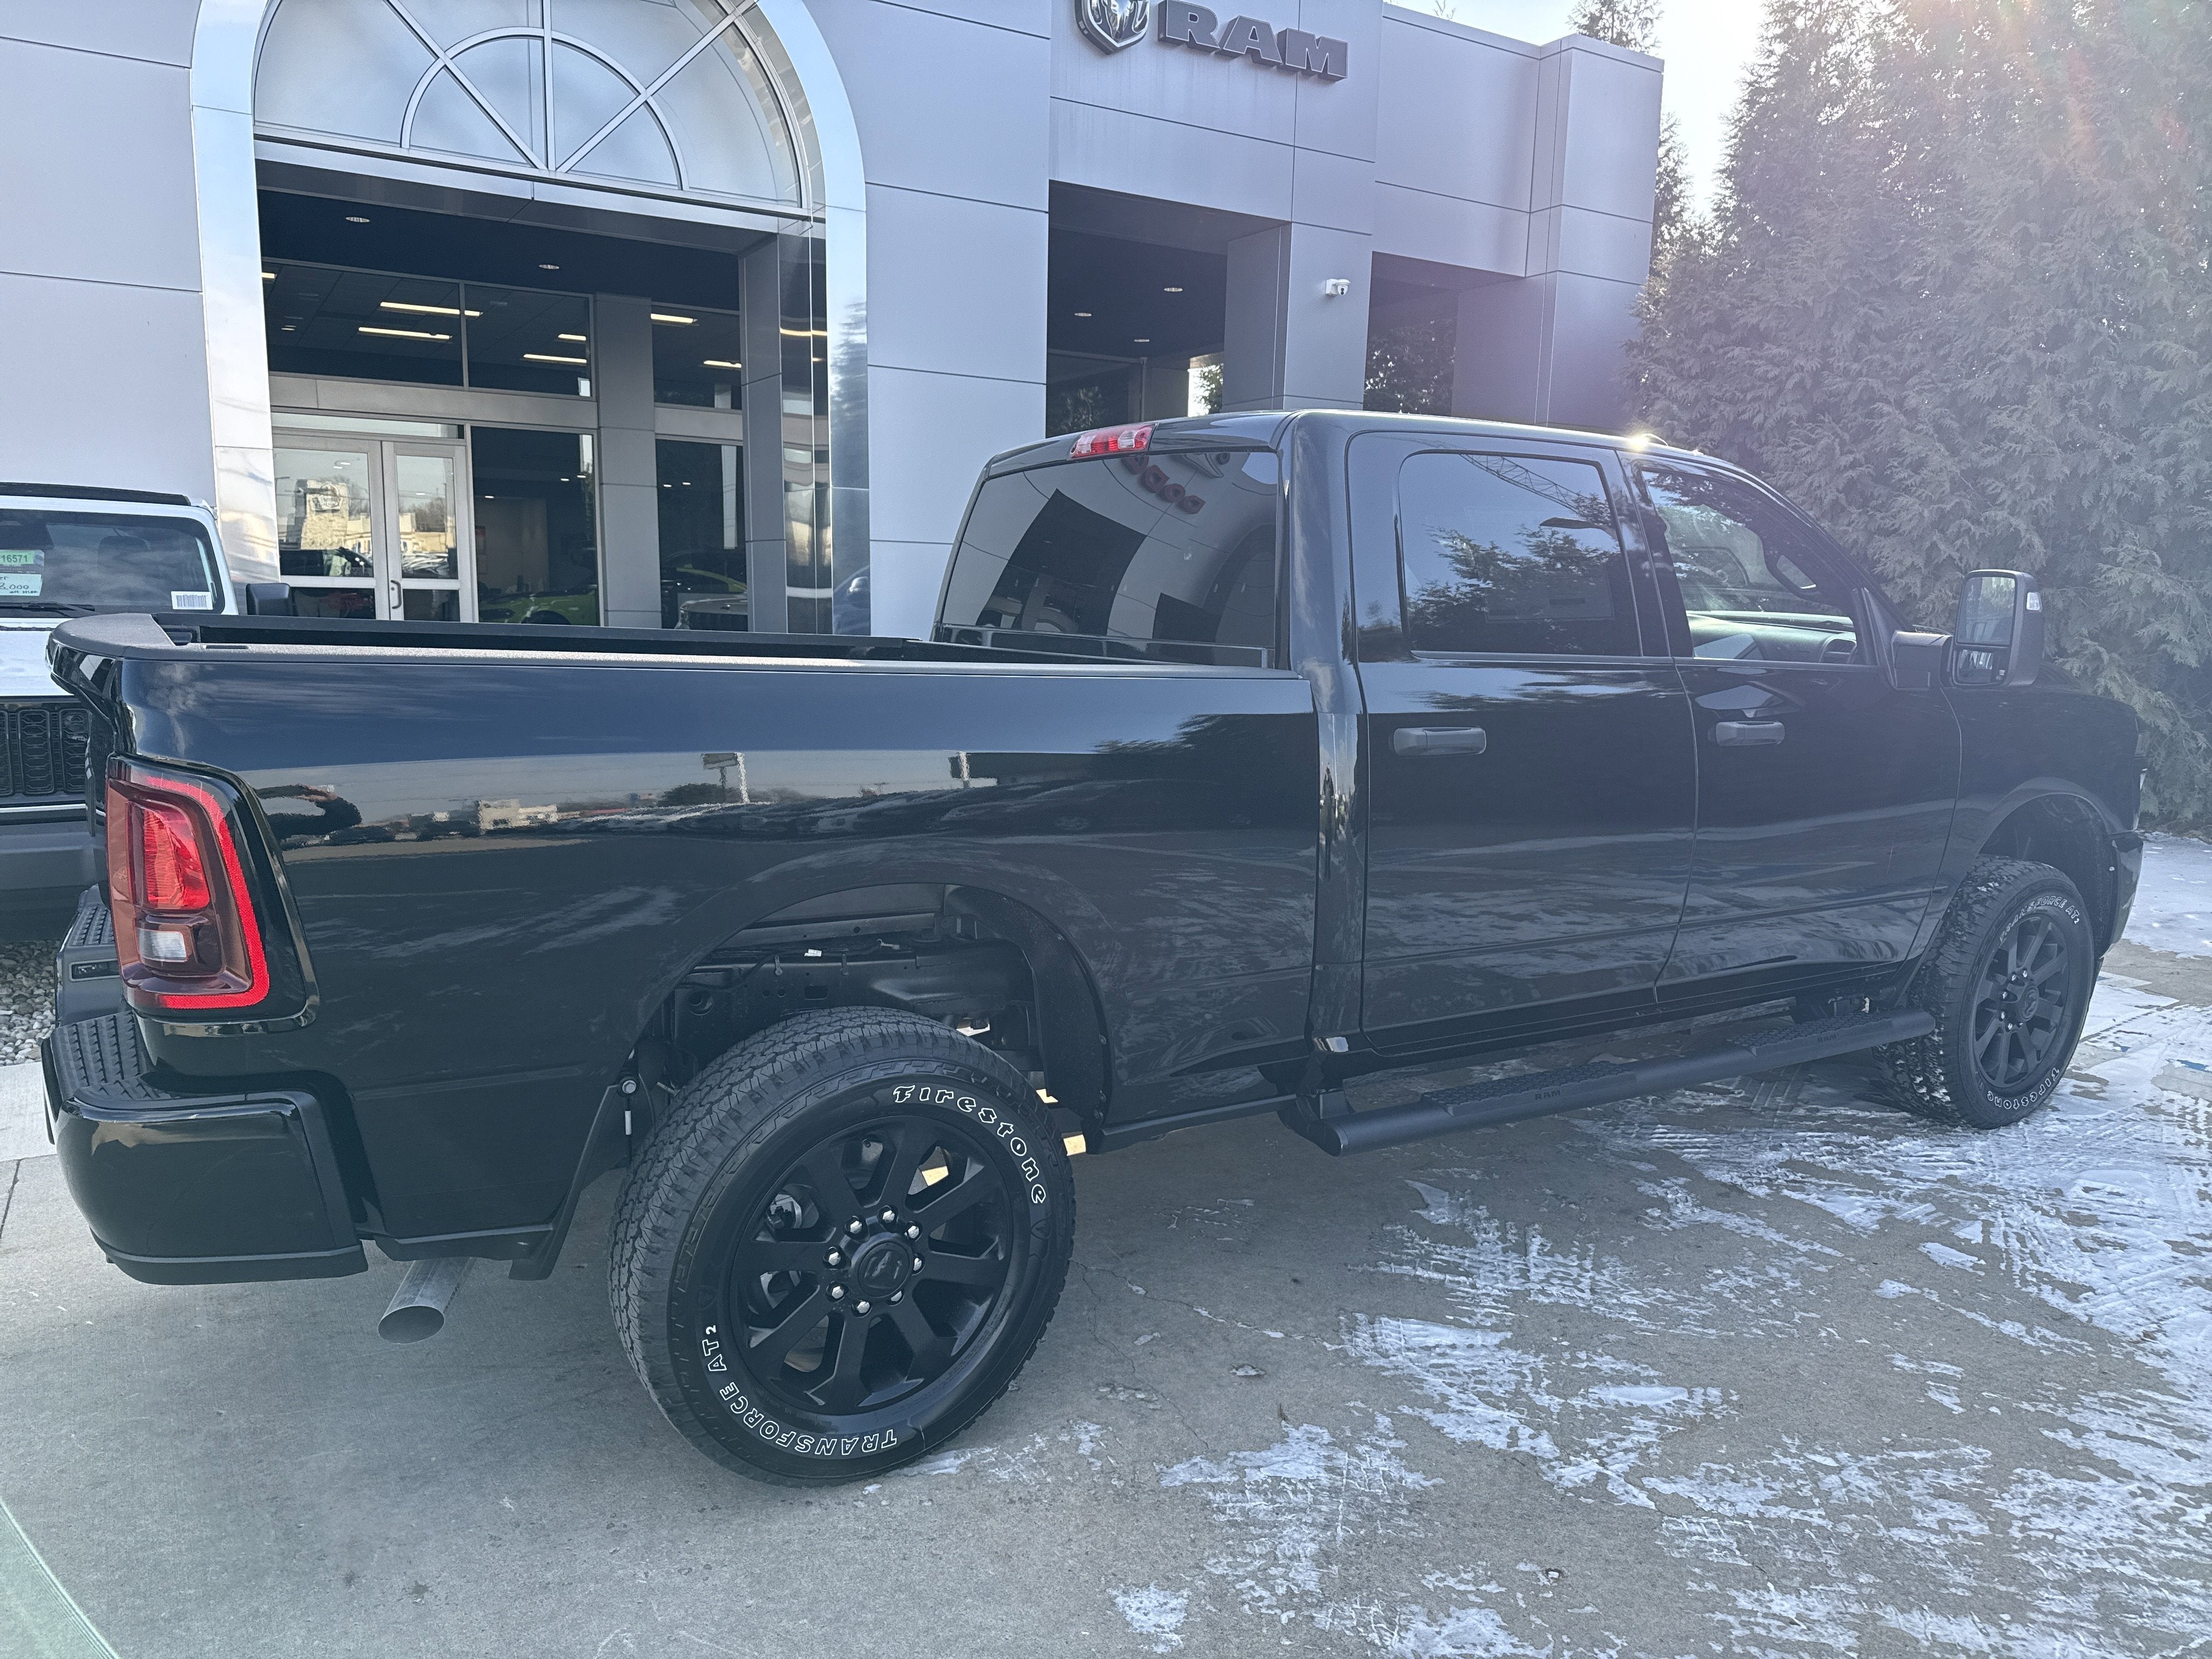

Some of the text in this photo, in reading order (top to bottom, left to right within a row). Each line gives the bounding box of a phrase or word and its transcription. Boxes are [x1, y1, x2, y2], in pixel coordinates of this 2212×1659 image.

[1158, 0, 1348, 81] RAM
[1534, 1090, 1561, 1100] RAM
[719, 1381, 898, 1455] TRANSFORCE
